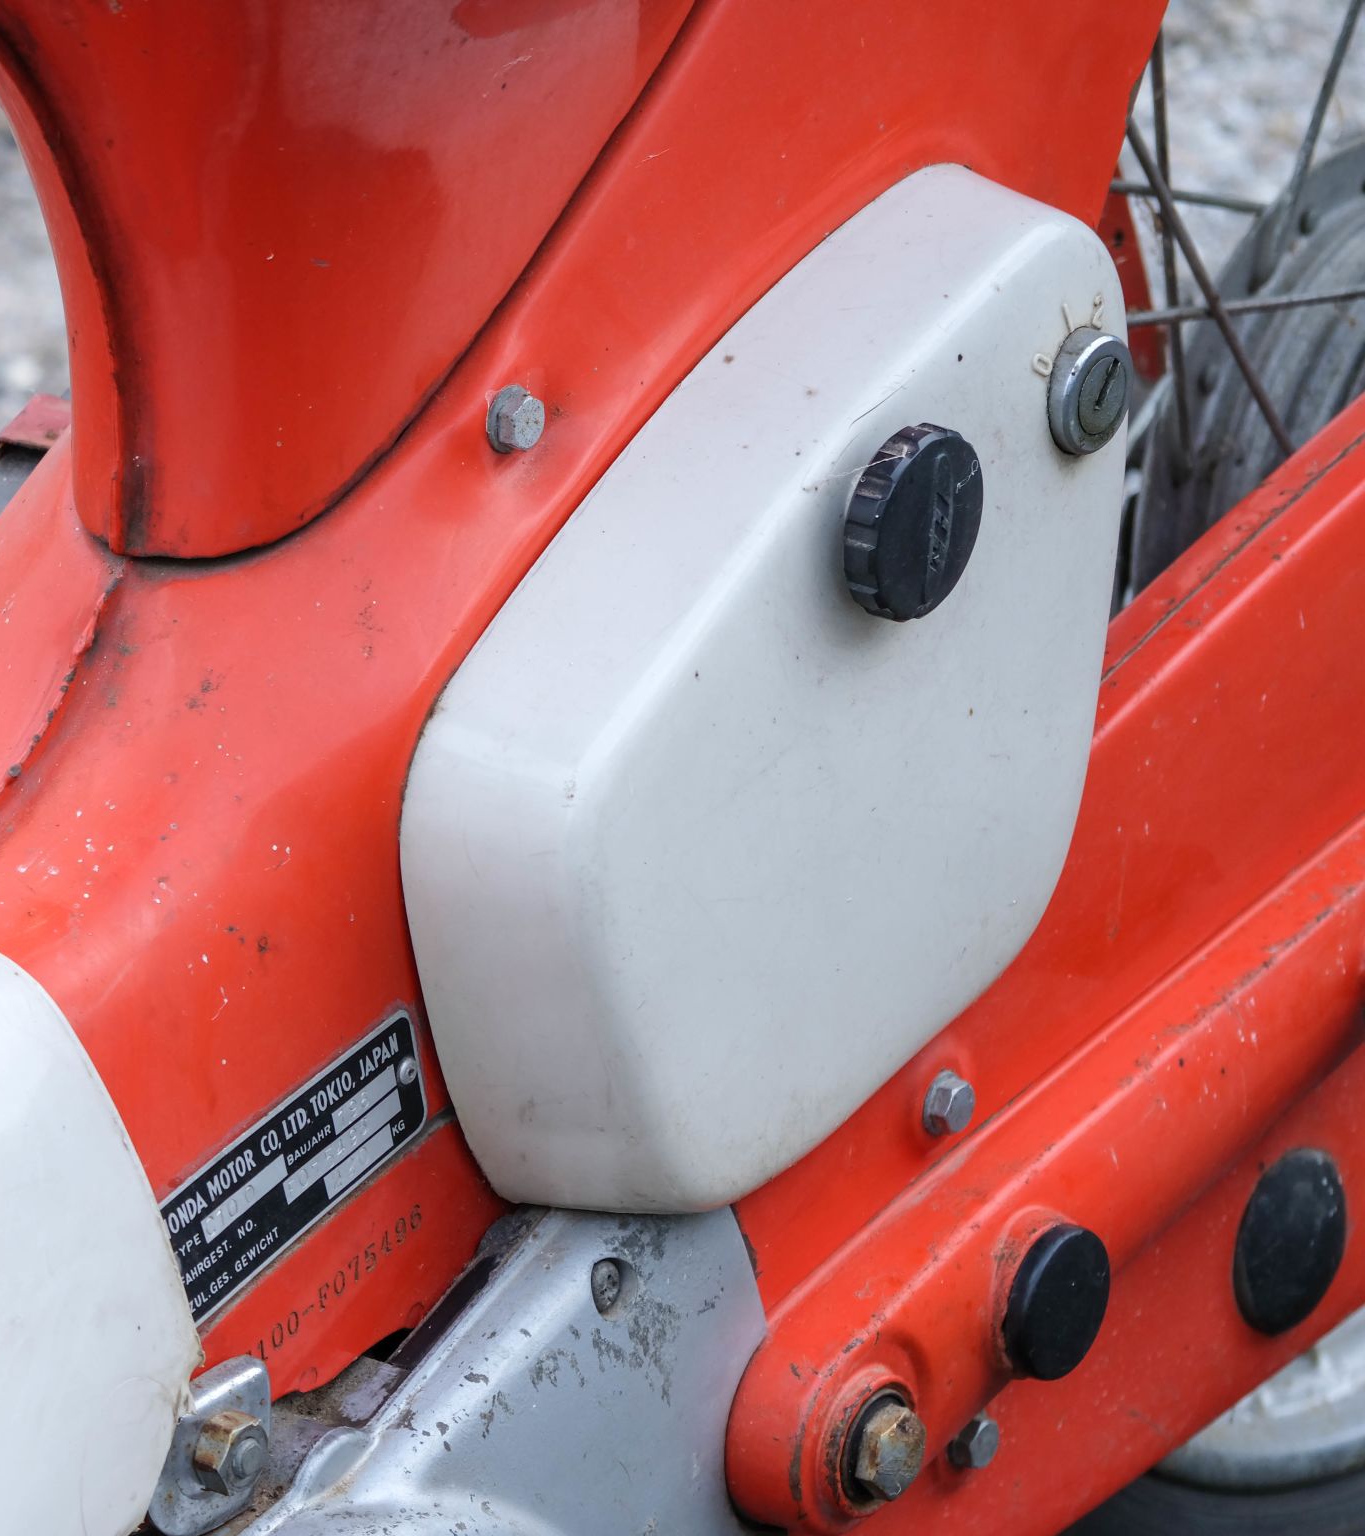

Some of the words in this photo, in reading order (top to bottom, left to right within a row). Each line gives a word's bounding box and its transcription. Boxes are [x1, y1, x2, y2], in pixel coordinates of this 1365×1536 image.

[163, 1191, 209, 1240] ONDA
[206, 1148, 257, 1202] MOTOR
[282, 1107, 311, 1141] LTD.
[310, 1071, 356, 1117] TOKIO,
[359, 1032, 399, 1080] JAPAN
[234, 1226, 279, 1273] GEWICHT
[391, 1119, 406, 1137] KG
[286, 1123, 332, 1166] BAUJAHR
[237, 1219, 258, 1240] NO.
[245, 1204, 423, 1361] 100-F075496
